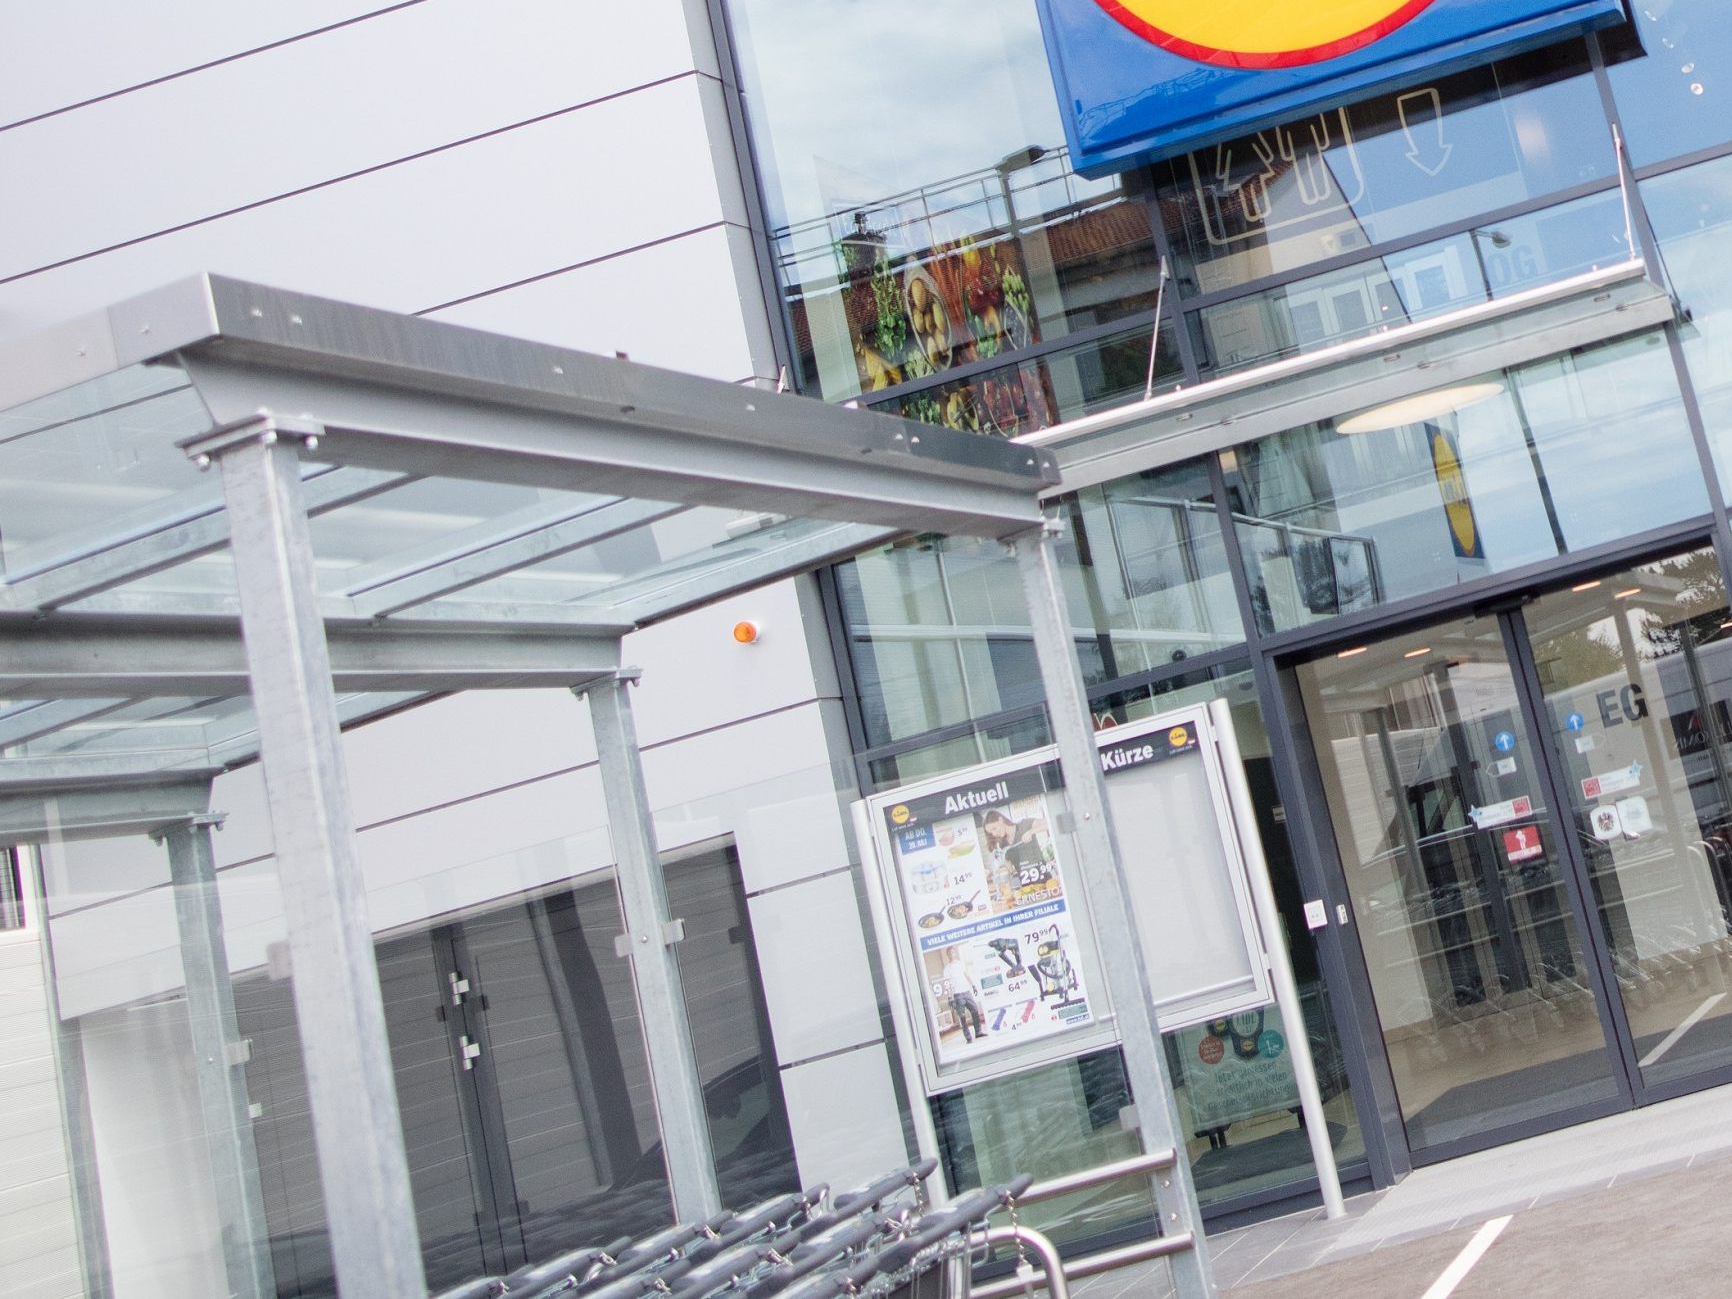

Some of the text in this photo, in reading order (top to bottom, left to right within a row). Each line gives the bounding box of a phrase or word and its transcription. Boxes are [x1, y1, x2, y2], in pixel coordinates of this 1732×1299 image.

[1596, 681, 1649, 729] EG
[1100, 745, 1154, 771] Kürze
[944, 781, 1009, 815] Aktuell
[927, 904, 1059, 946] VIELE WEITERE ARTIKEL IN IHRER FILIALE
